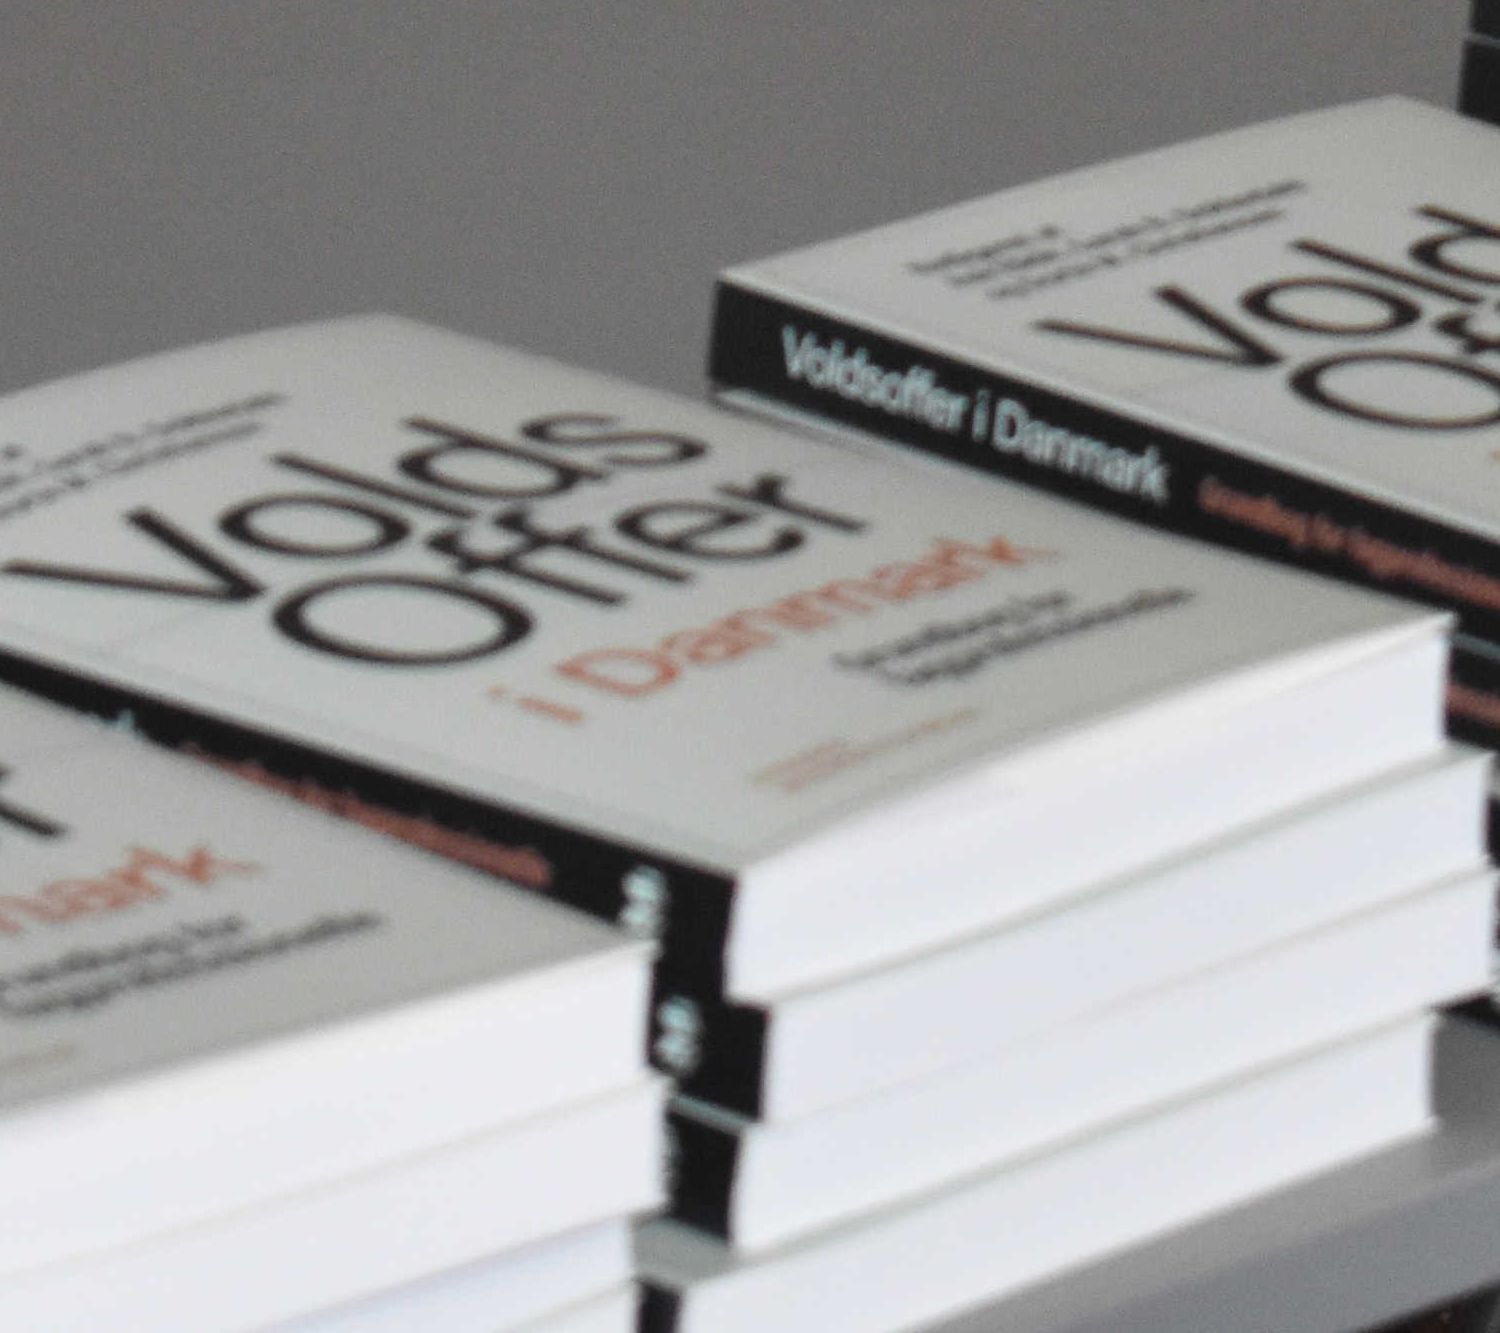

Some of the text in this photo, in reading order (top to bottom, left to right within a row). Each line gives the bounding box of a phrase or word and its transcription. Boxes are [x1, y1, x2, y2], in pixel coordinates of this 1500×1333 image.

[779, 324, 1171, 506] Voldsoffer i Danmark
[270, 470, 868, 669] Offer
[555, 531, 1065, 701] Danmark
